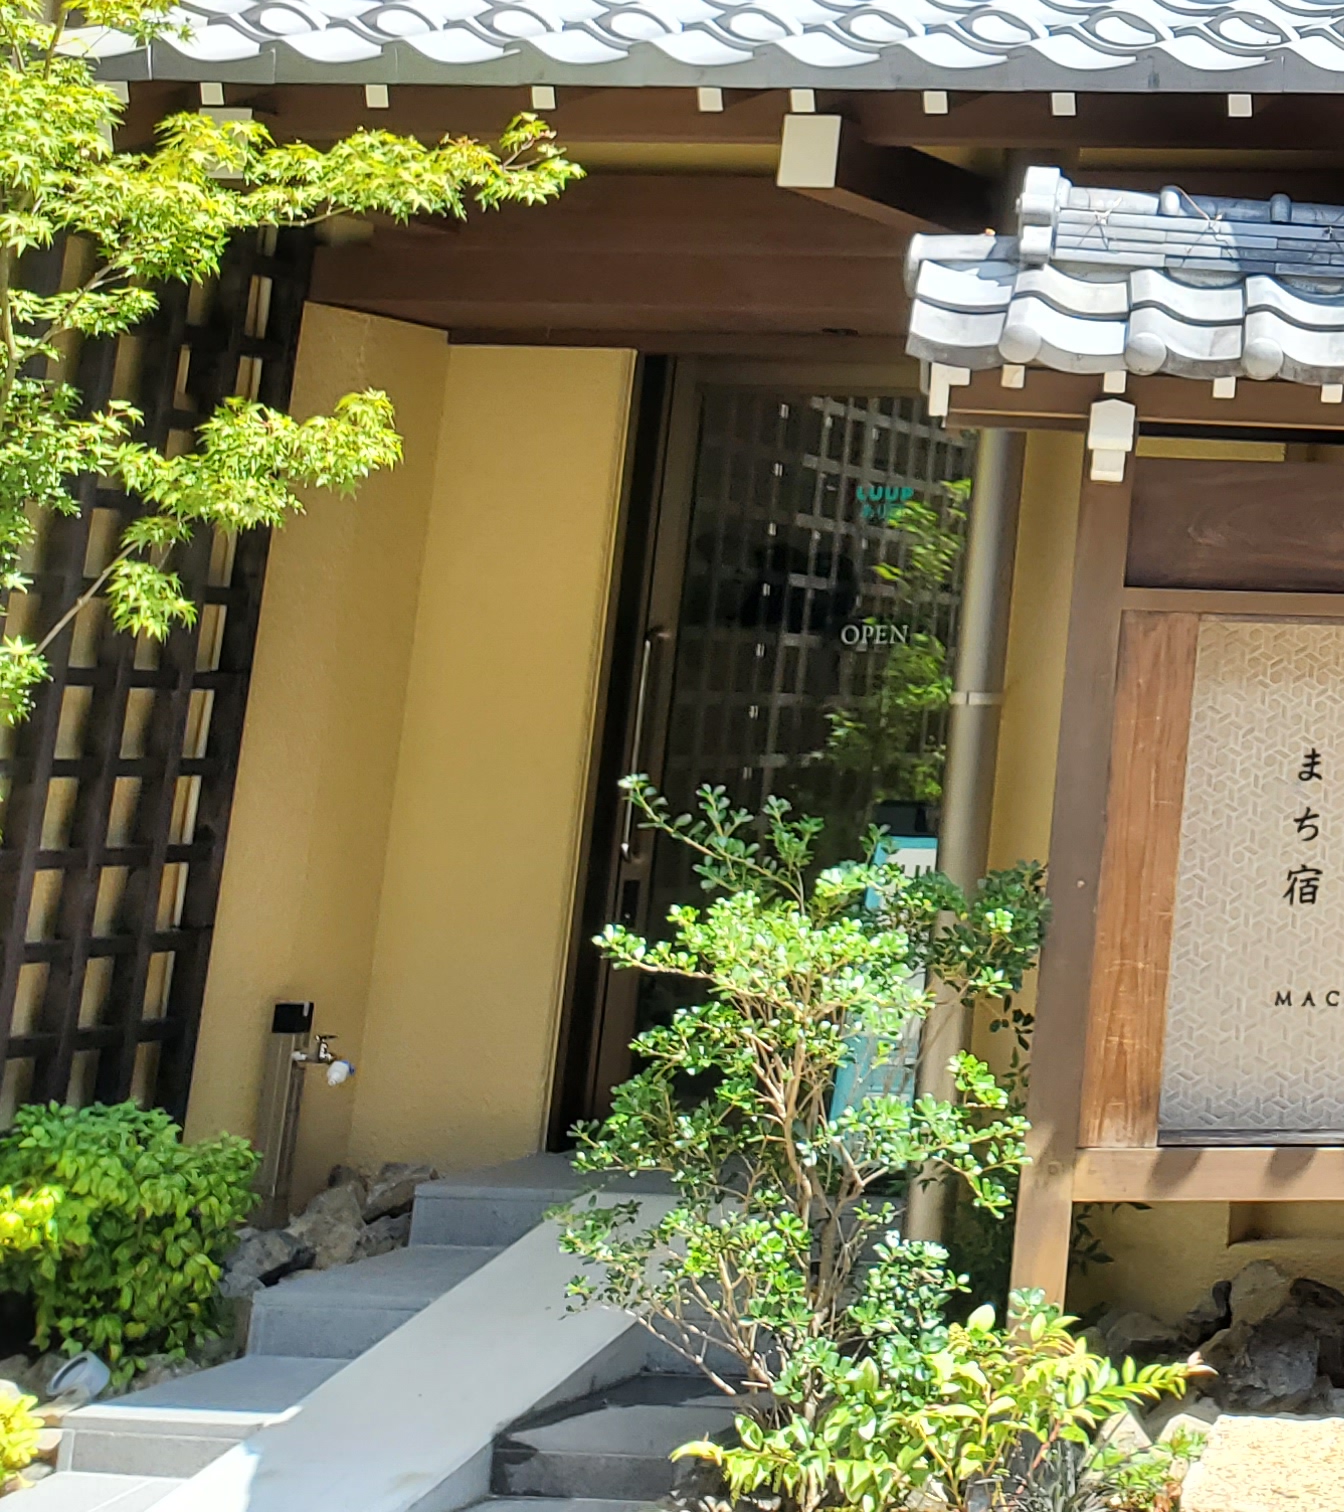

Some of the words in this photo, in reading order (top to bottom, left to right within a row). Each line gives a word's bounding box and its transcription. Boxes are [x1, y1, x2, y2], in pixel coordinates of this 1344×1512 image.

[841, 624, 909, 645] OPEN
[1282, 747, 1324, 906] まち宿
